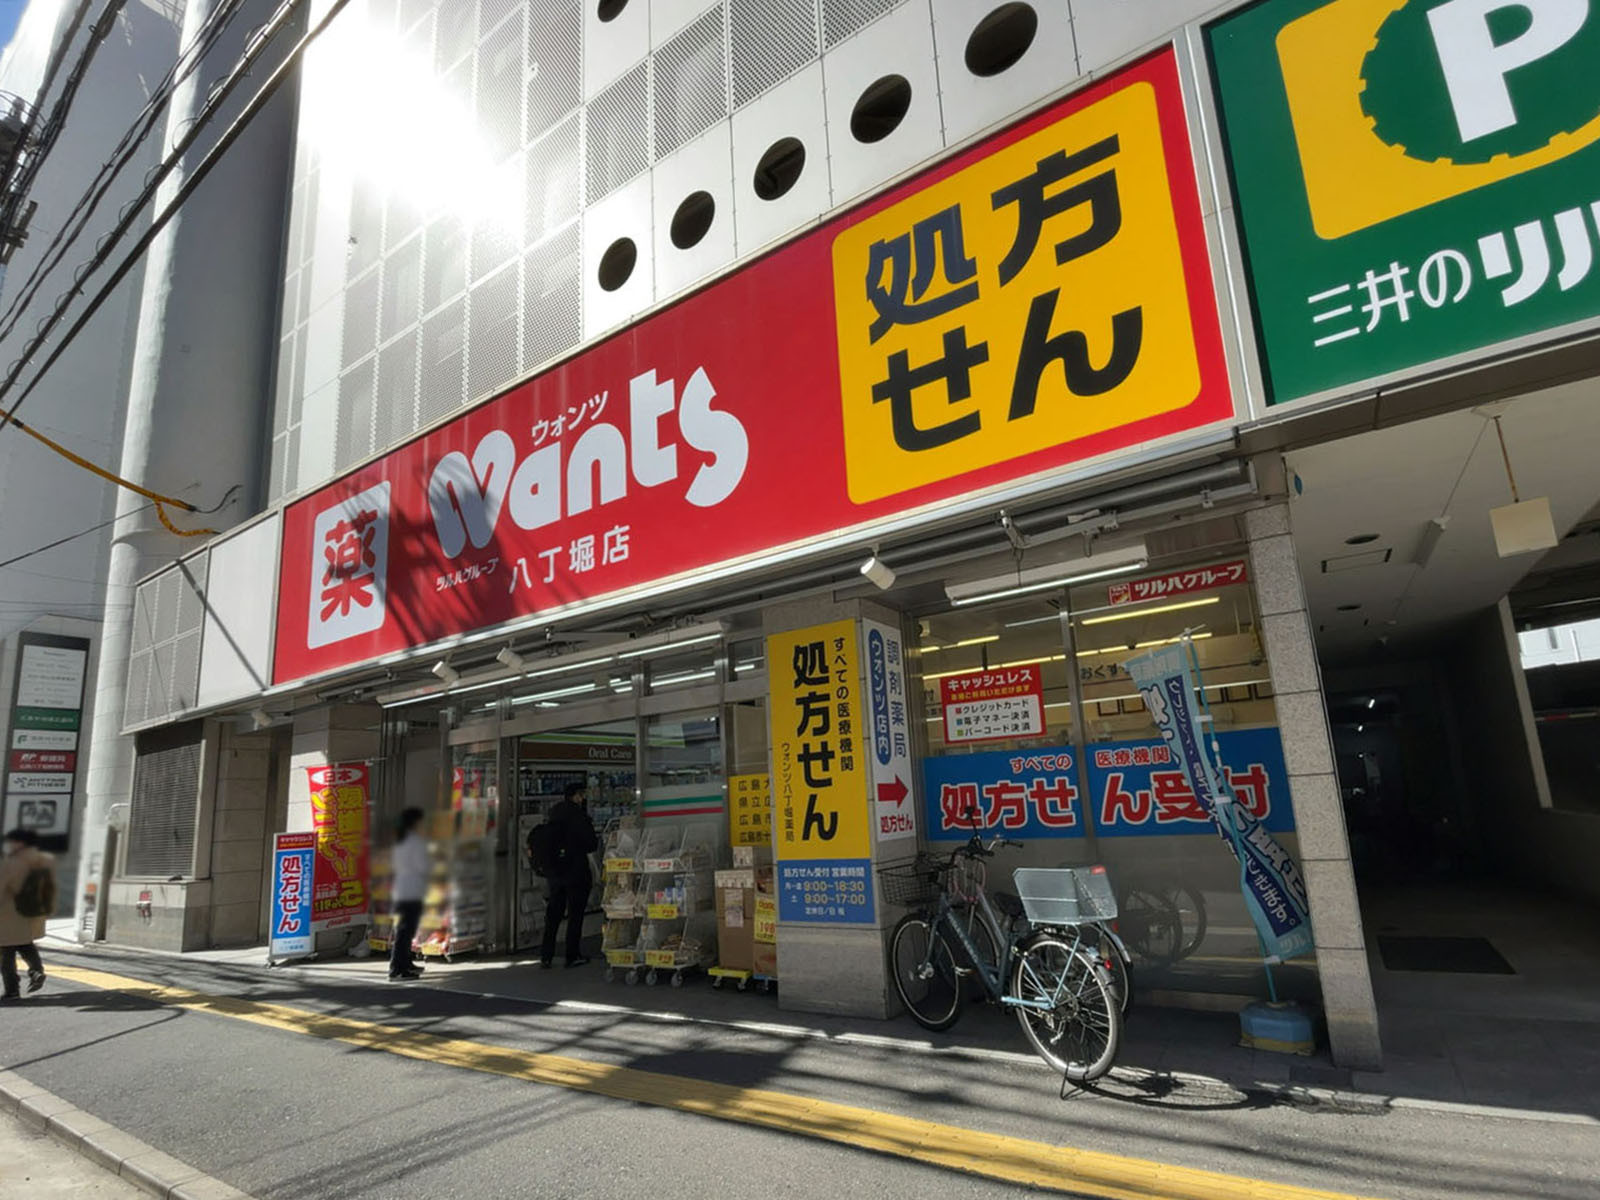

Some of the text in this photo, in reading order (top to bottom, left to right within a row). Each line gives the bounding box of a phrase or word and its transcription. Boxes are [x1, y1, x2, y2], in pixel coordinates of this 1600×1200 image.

[1427, 0, 1590, 143] P
[866, 134, 1122, 345] 処方
[871, 287, 1143, 452] せん
[531, 390, 608, 446] ウォンツ
[428, 366, 749, 559] Wants
[320, 508, 378, 622] 薬
[508, 525, 630, 593] 八丁堀店
[1135, 564, 1244, 597] ツルハグループ
[834, 637, 854, 771] すべての医療機関
[948, 670, 1033, 691] キャッシュレス
[963, 700, 1029, 714] クレジットカード
[793, 641, 839, 841] 処方せん
[964, 711, 1030, 726] 電子マネー決済
[965, 722, 1031, 737] バーコード決済
[589, 747, 608, 759] Oral
[1010, 746, 1170, 774] すべての 医療機関
[880, 814, 913, 833] 処方せん
[940, 776, 1077, 829] 処方せ
[277, 855, 302, 935] 処方せん
